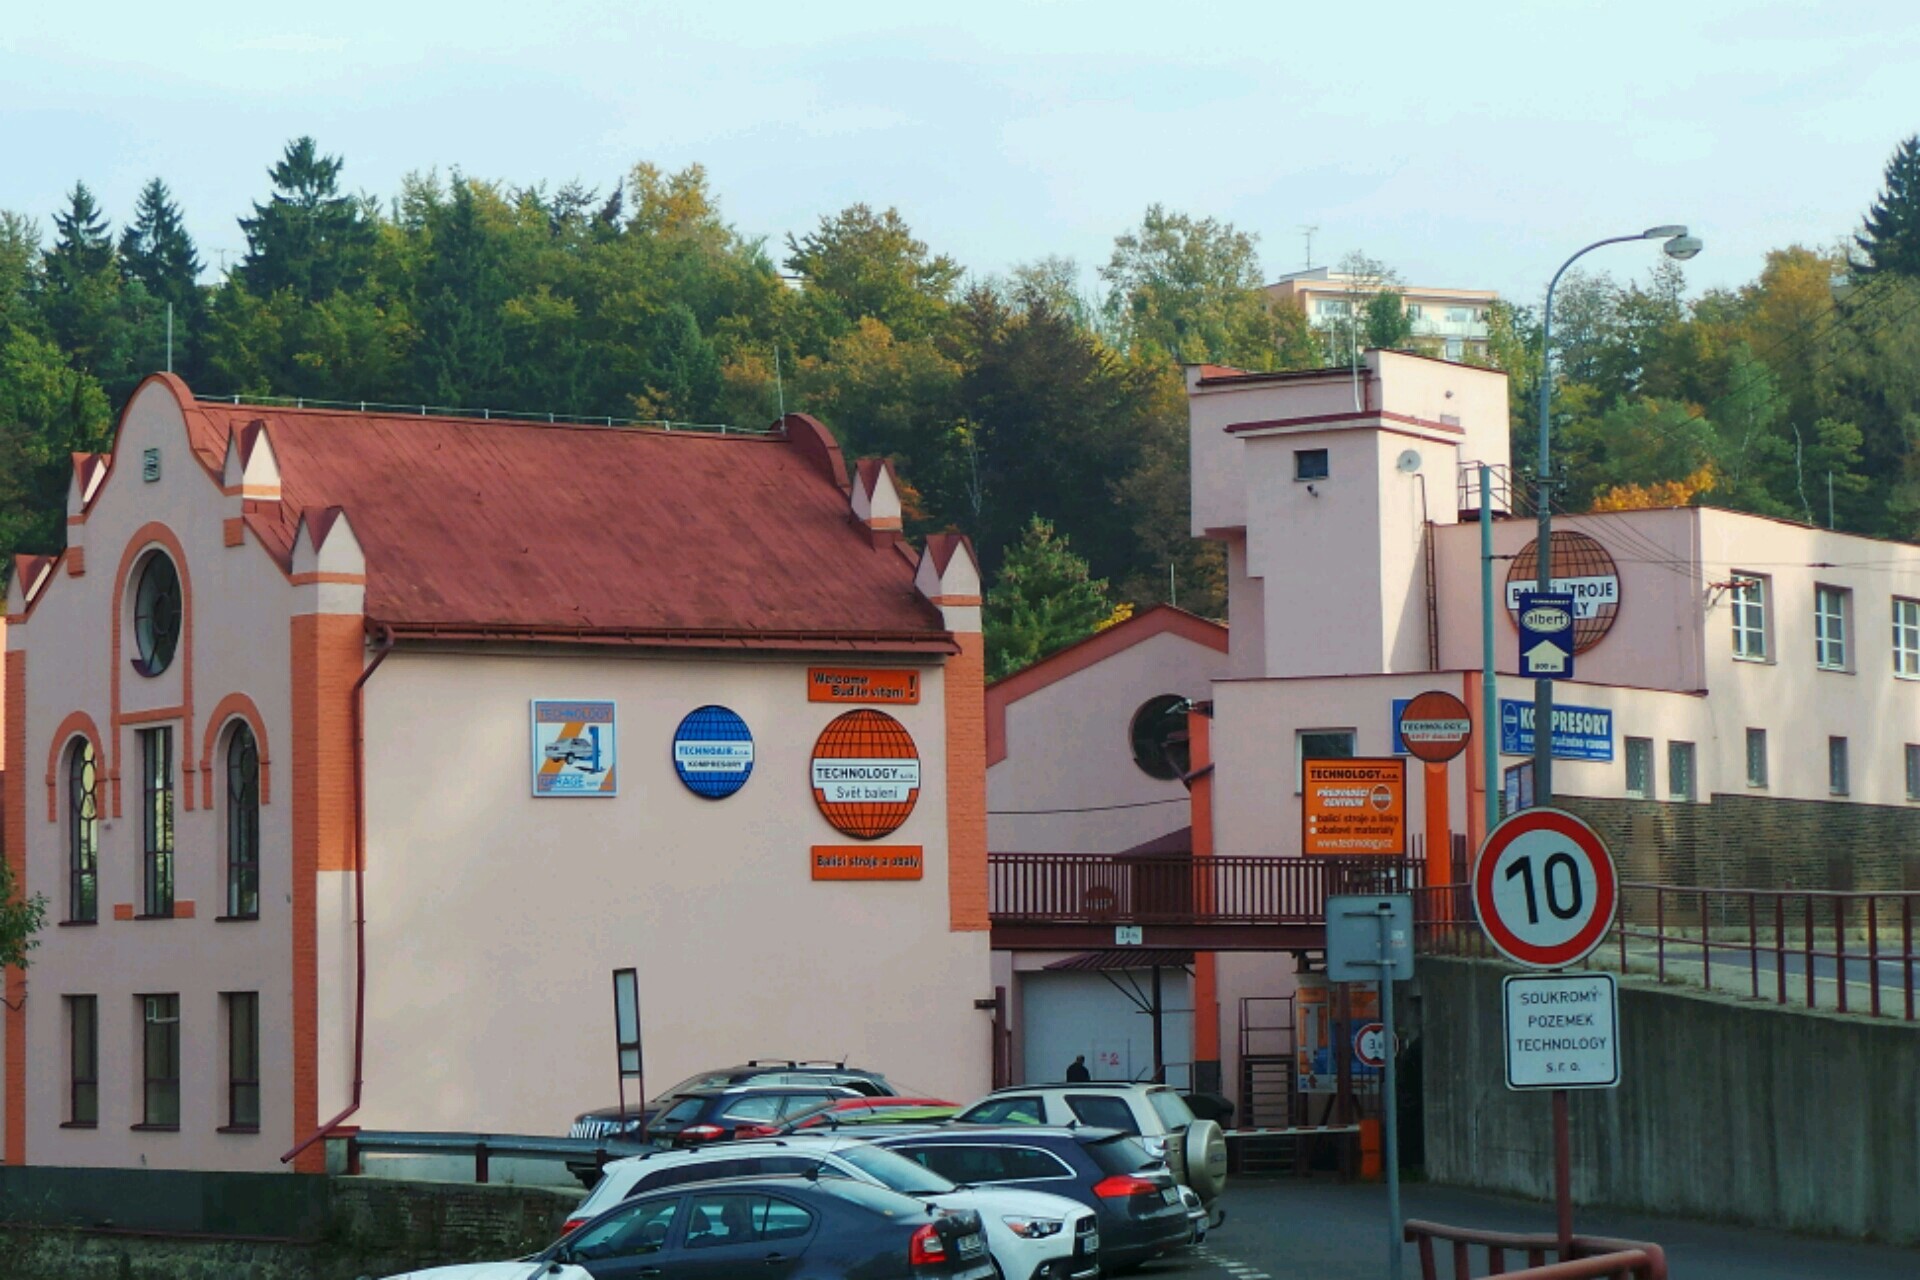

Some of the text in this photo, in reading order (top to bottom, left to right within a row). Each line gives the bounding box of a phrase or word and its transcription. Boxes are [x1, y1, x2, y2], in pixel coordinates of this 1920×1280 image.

[1528, 614, 1563, 625] albert
[814, 673, 868, 684] Welcome
[540, 706, 609, 719] TECHNOLOGY
[1404, 723, 1462, 731] TECHNOLOGY
[1520, 707, 1609, 736] KOPRESORY
[679, 746, 733, 755] TECHNOAIR
[688, 761, 742, 769] KOMPRESORY
[816, 768, 898, 779] TECHNOLOGY
[1310, 770, 1381, 779] TECHNOLOGY
[1323, 799, 1364, 807] CENTRUM
[1344, 815, 1369, 825] stroje
[1505, 852, 1583, 925] 10
[1520, 986, 1598, 1005] SOUKROMÝ
[1528, 1014, 1594, 1028] POZEMEK
[1517, 1037, 1607, 1052] TECHNOLOGY
